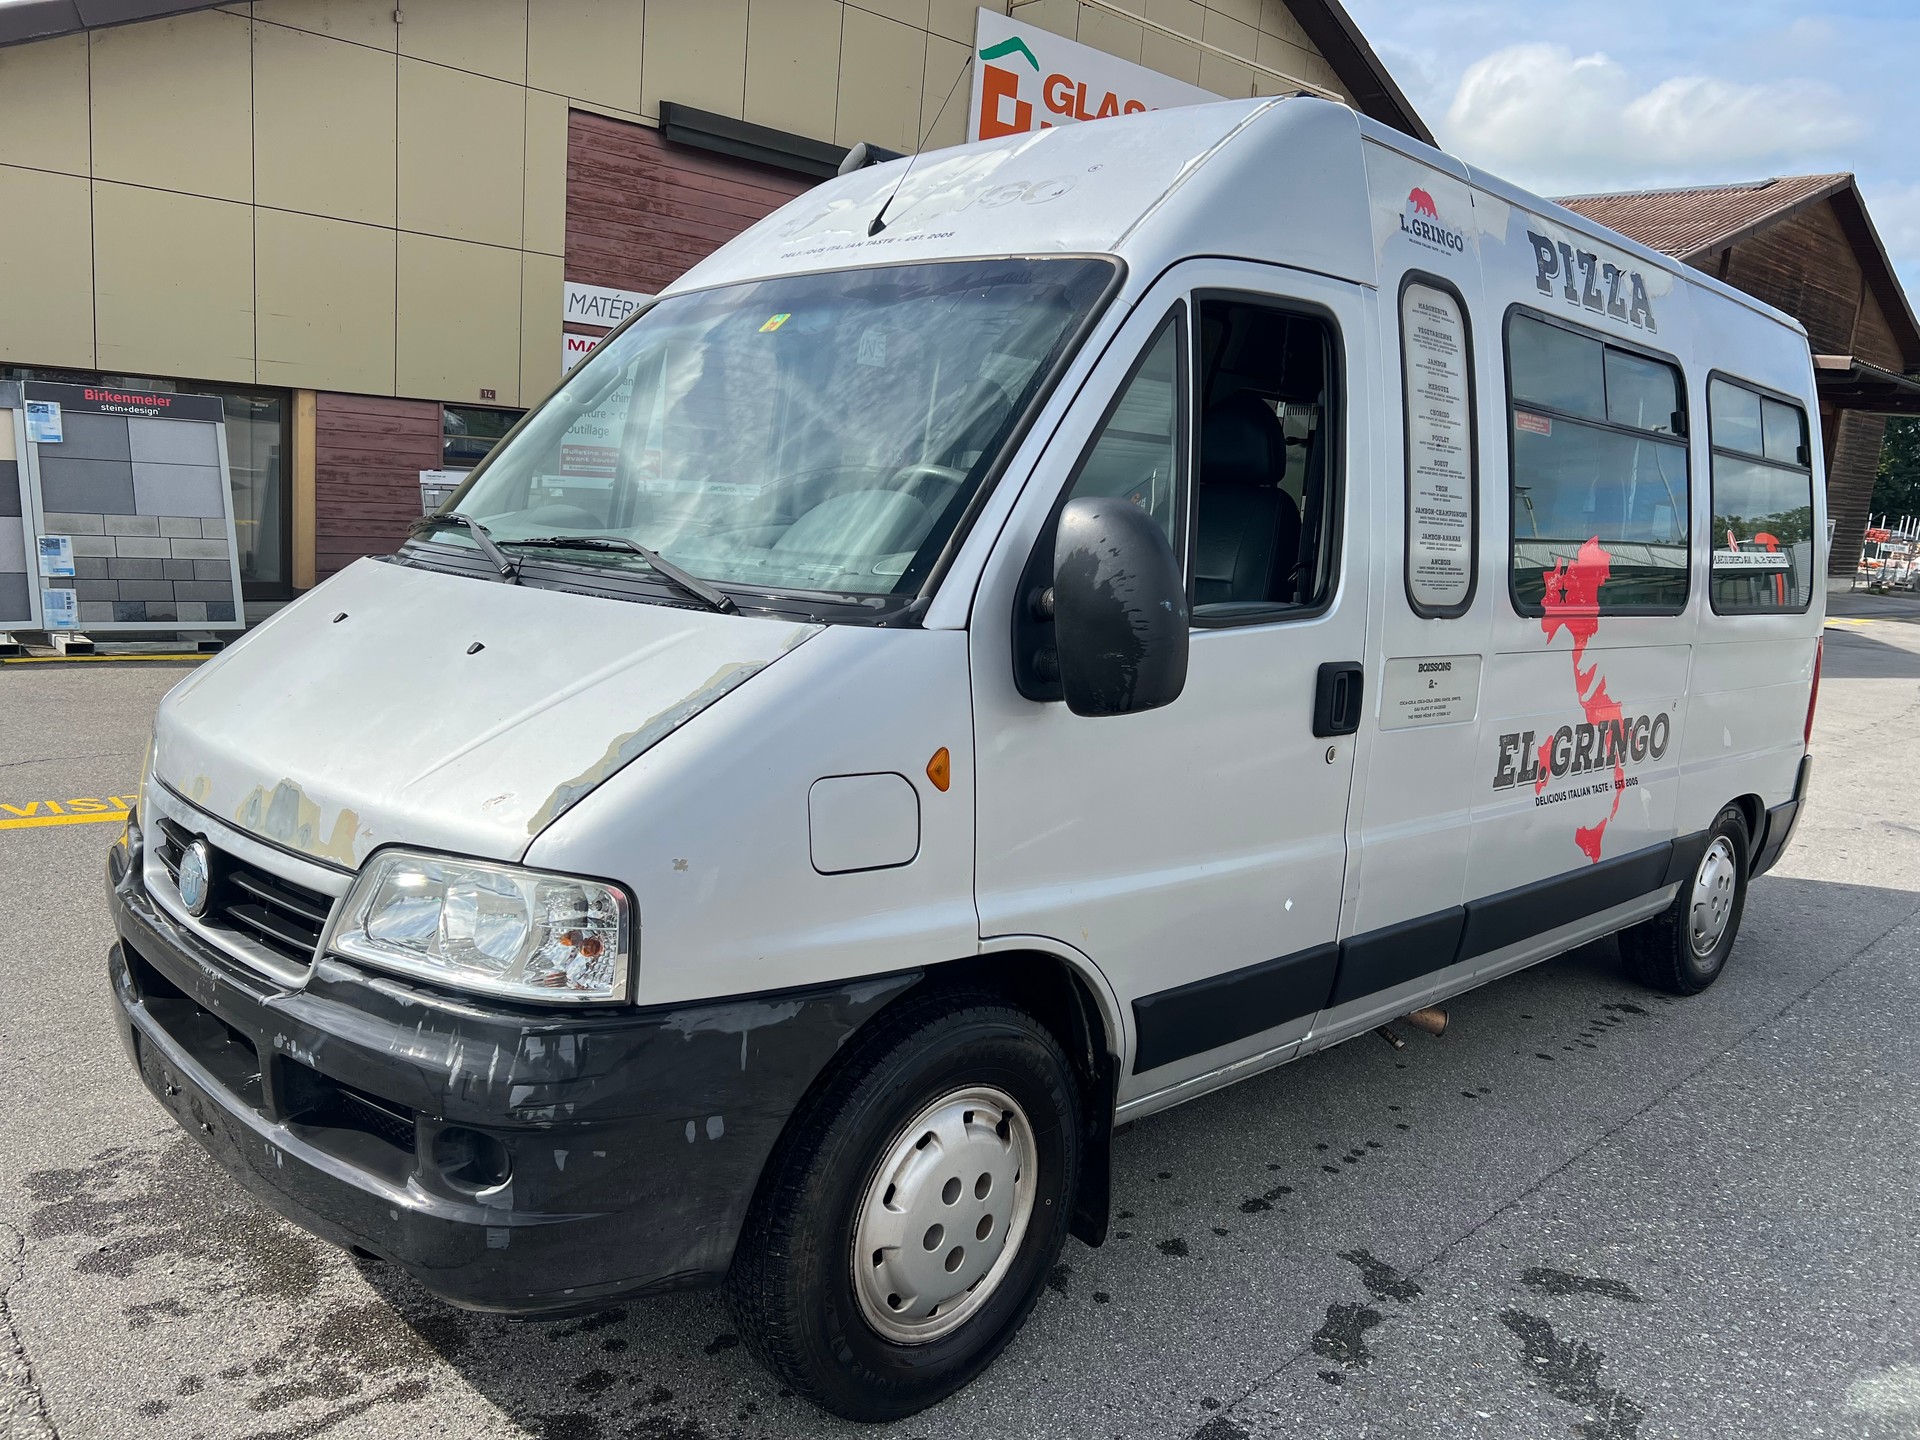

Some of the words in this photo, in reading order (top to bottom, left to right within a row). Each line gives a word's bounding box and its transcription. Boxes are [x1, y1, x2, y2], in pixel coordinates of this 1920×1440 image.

[1043, 73, 1160, 122] GLA
[865, 237, 896, 247] TASTE
[926, 231, 956, 239] 2005
[1526, 230, 1658, 335] PIZZA
[84, 388, 172, 407] Birkenmeier
[484, 390, 493, 398] 14
[1418, 662, 1452, 673] BOISSONS
[1493, 712, 1670, 791] EL.GRINGO
[1535, 791, 1567, 807] DELICIOUS
[1568, 786, 1591, 801] ITALIAN
[1592, 782, 1609, 794] TASTE
[1625, 776, 1639, 787] 2005
